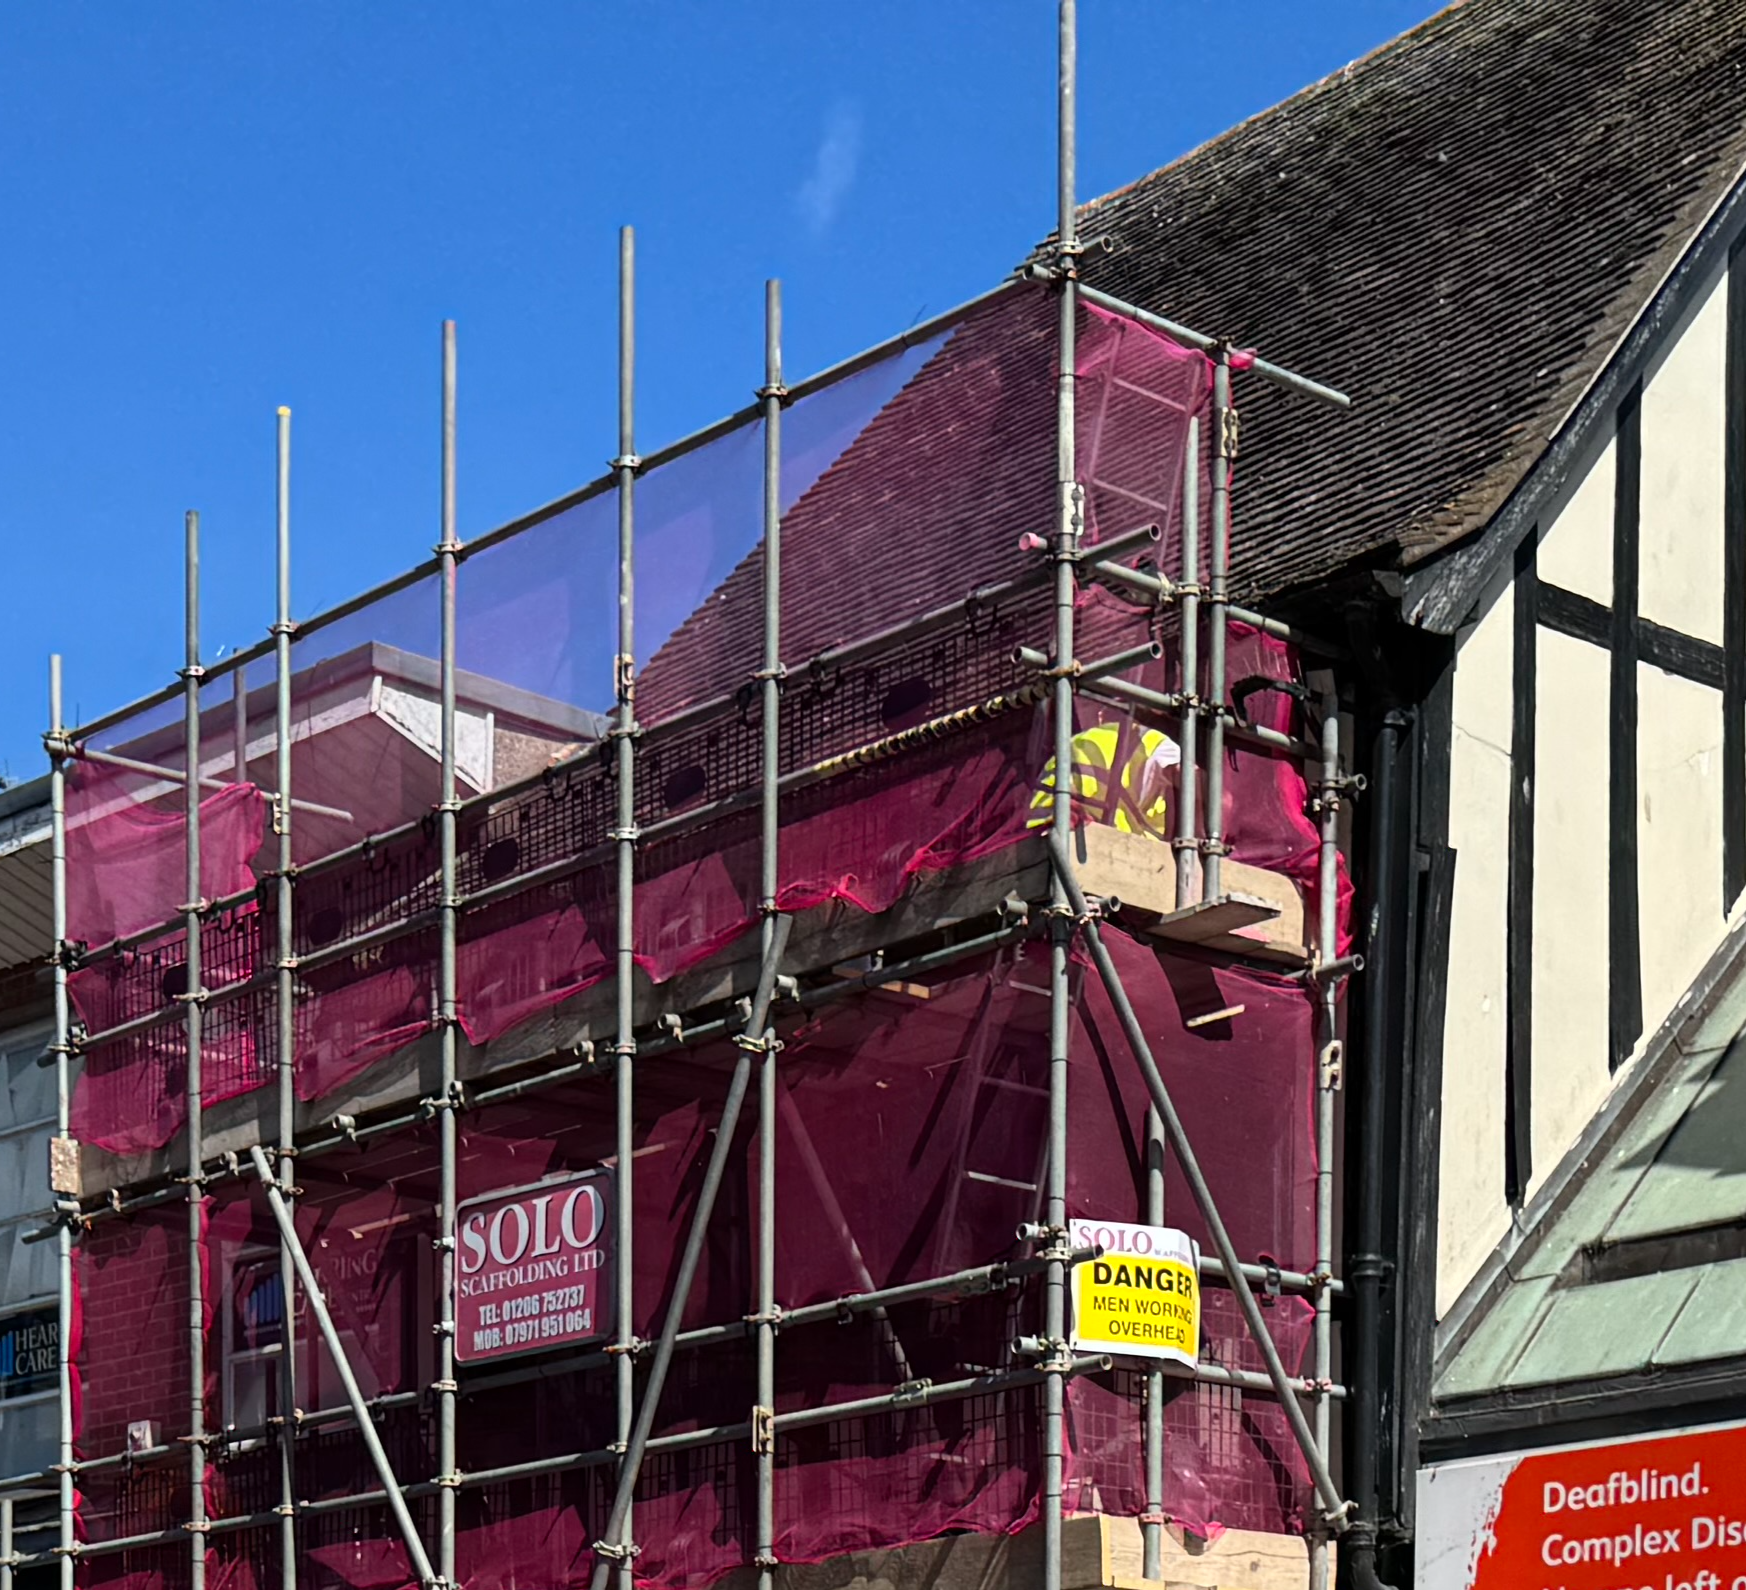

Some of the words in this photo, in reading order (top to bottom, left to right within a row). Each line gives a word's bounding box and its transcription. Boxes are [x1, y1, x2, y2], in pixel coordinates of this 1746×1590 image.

[461, 1184, 605, 1274] SOLO
[1079, 1225, 1153, 1255] SOLO
[460, 1257, 569, 1298] SCAFFOLDING
[574, 1249, 605, 1274] LTD
[1093, 1262, 1193, 1300] DANGER
[479, 1305, 501, 1326] TEL:
[503, 1295, 540, 1322] 01206
[542, 1285, 585, 1314] 752737
[1093, 1296, 1130, 1313] MEN
[1135, 1299, 1193, 1325] WORKNG
[15, 1321, 60, 1350] HEAR
[473, 1330, 504, 1352] MOB:
[505, 1320, 540, 1345] 07971
[541, 1313, 564, 1337] 951
[565, 1308, 592, 1332] 064
[14, 1346, 59, 1376] CARE
[1542, 1463, 1710, 1513] Deafblind.
[1541, 1525, 1681, 1569] Complex
